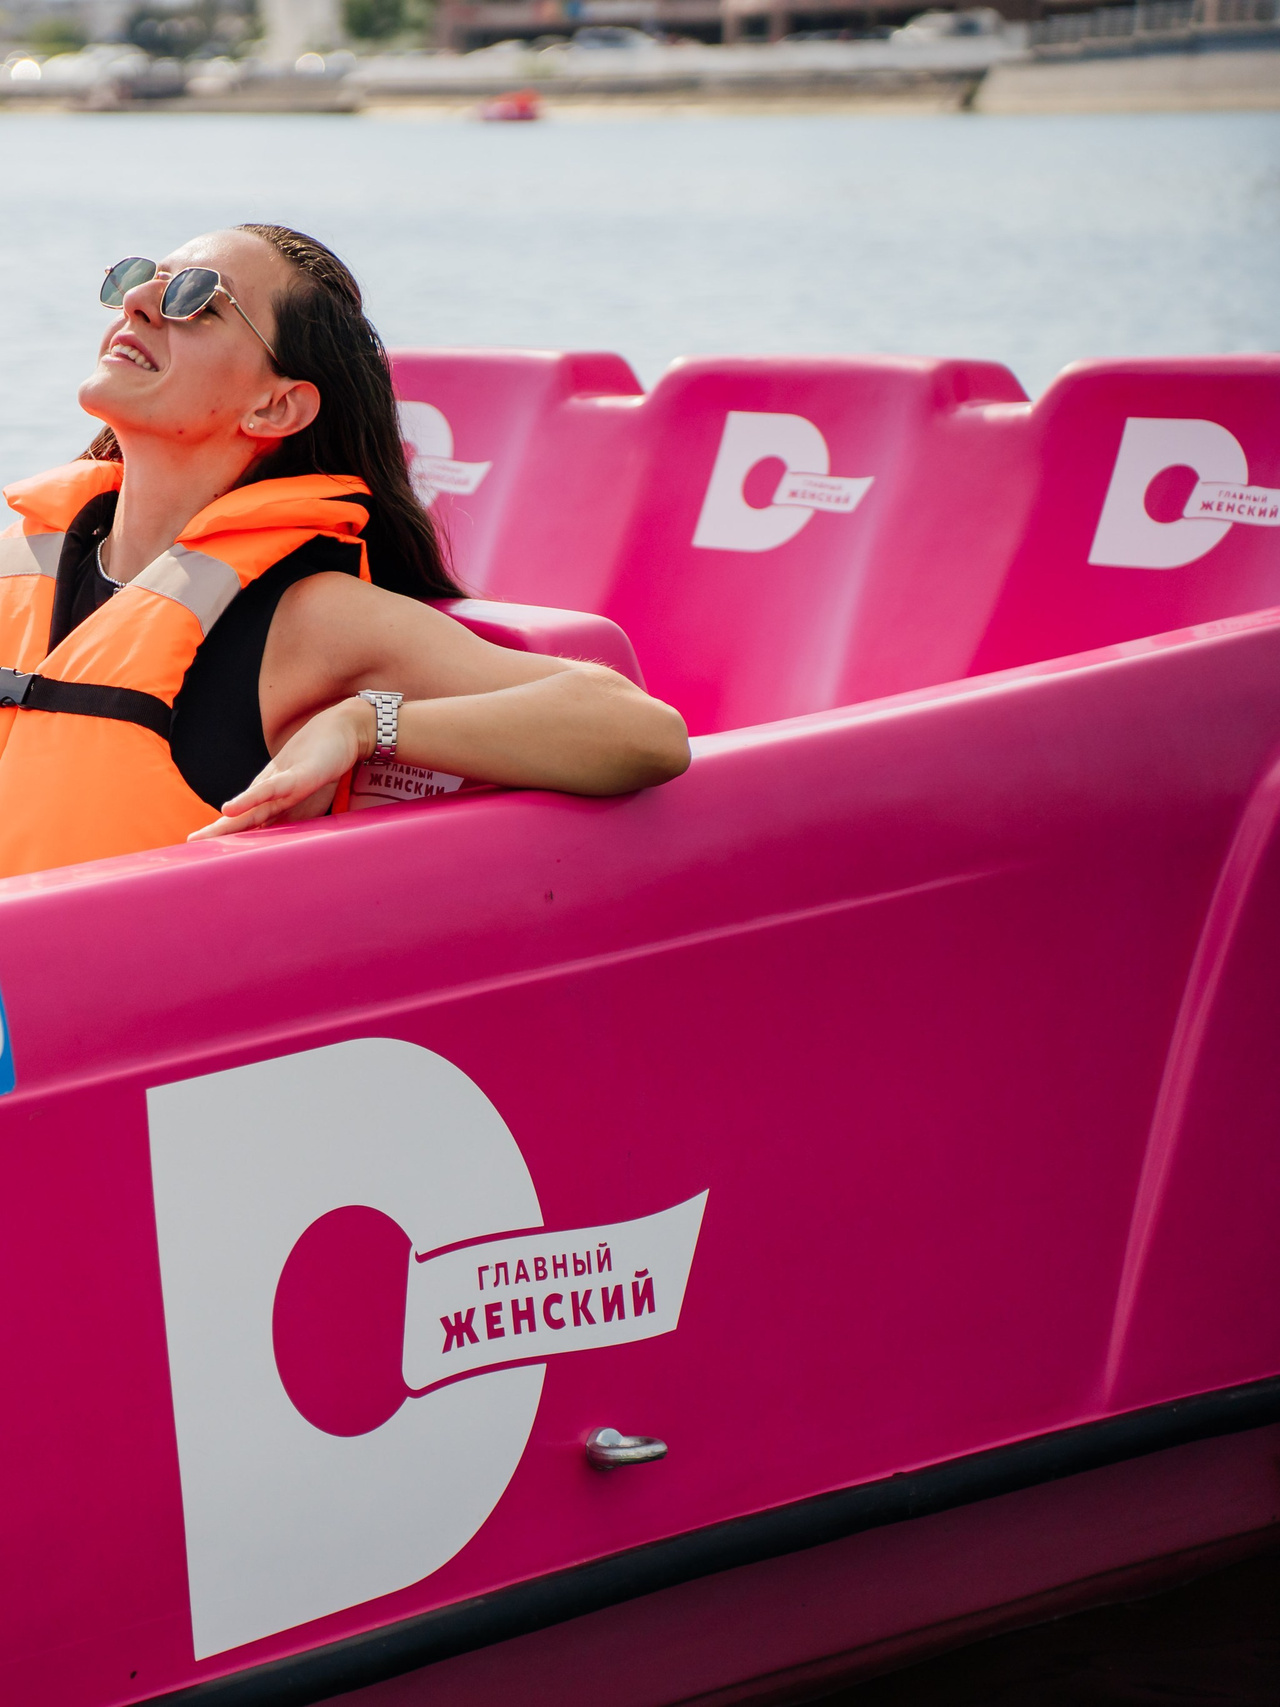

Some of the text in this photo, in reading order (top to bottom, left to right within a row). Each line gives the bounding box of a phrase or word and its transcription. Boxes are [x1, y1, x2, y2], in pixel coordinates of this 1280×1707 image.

[1200, 500, 1279, 518] ЖЕНСКИЙ
[477, 1242, 612, 1291] ГЛАВНЫЙ
[439, 1268, 656, 1354] ЖЕНСКИЙ
